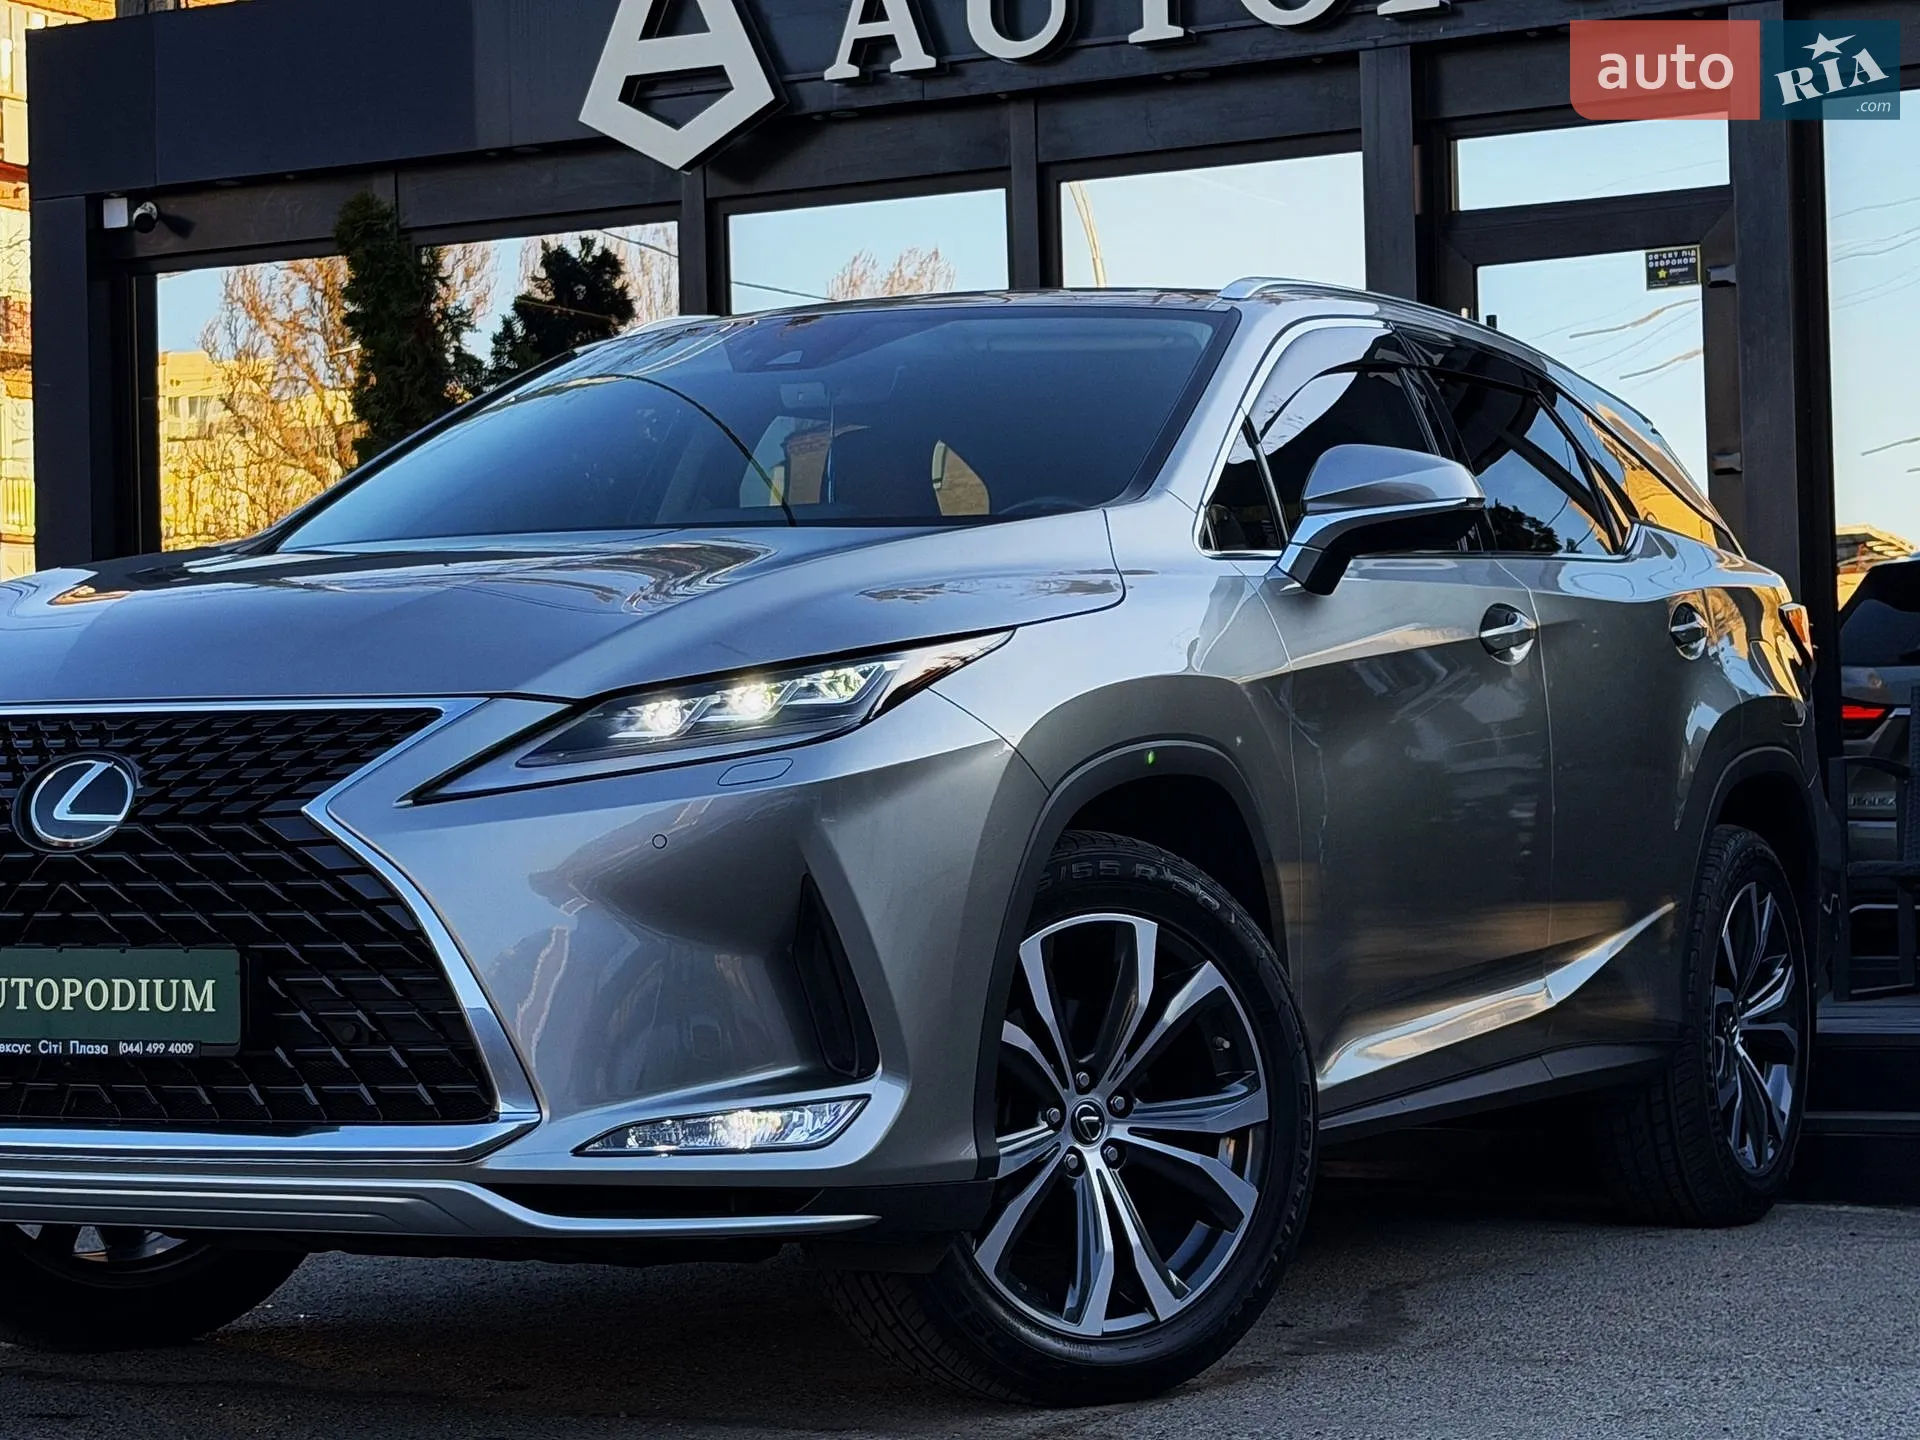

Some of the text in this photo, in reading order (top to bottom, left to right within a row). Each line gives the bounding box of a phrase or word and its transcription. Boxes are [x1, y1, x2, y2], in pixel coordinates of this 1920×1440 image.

[69, 1040, 109, 1055] Плаза
[118, 1041, 143, 1055] (044)
[145, 1042, 166, 1054] 499
[168, 1043, 195, 1055] 4009
